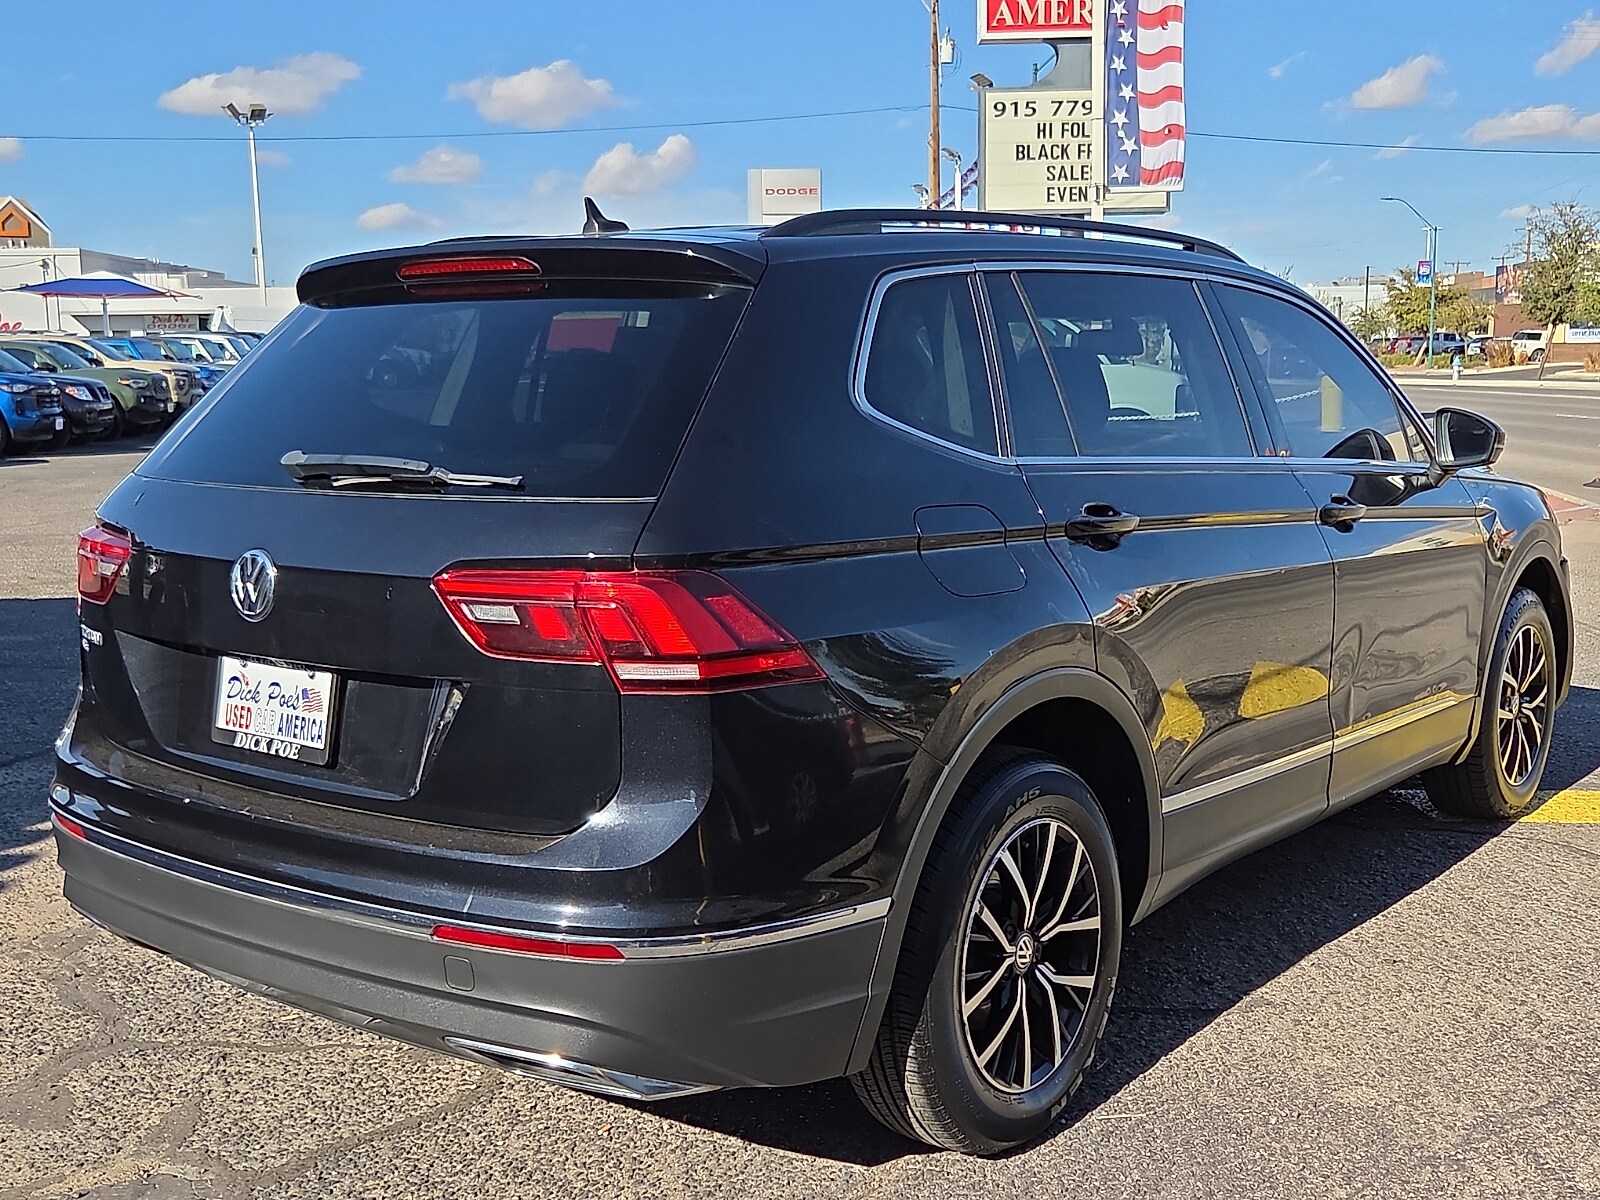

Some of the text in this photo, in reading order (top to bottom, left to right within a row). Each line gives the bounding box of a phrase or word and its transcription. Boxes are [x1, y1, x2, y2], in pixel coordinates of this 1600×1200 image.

[993, 99, 1092, 118] 915 779
[1037, 121, 1091, 139] HI FOL
[1015, 143, 1071, 161] BLACK
[1046, 165, 1092, 181] SALE
[765, 188, 818, 196] DODGE
[227, 675, 301, 711] Dick Poe's
[225, 703, 323, 744] USED CAR AMERICA
[233, 732, 301, 760] DICK POE
[1003, 785, 1041, 822] AH5
